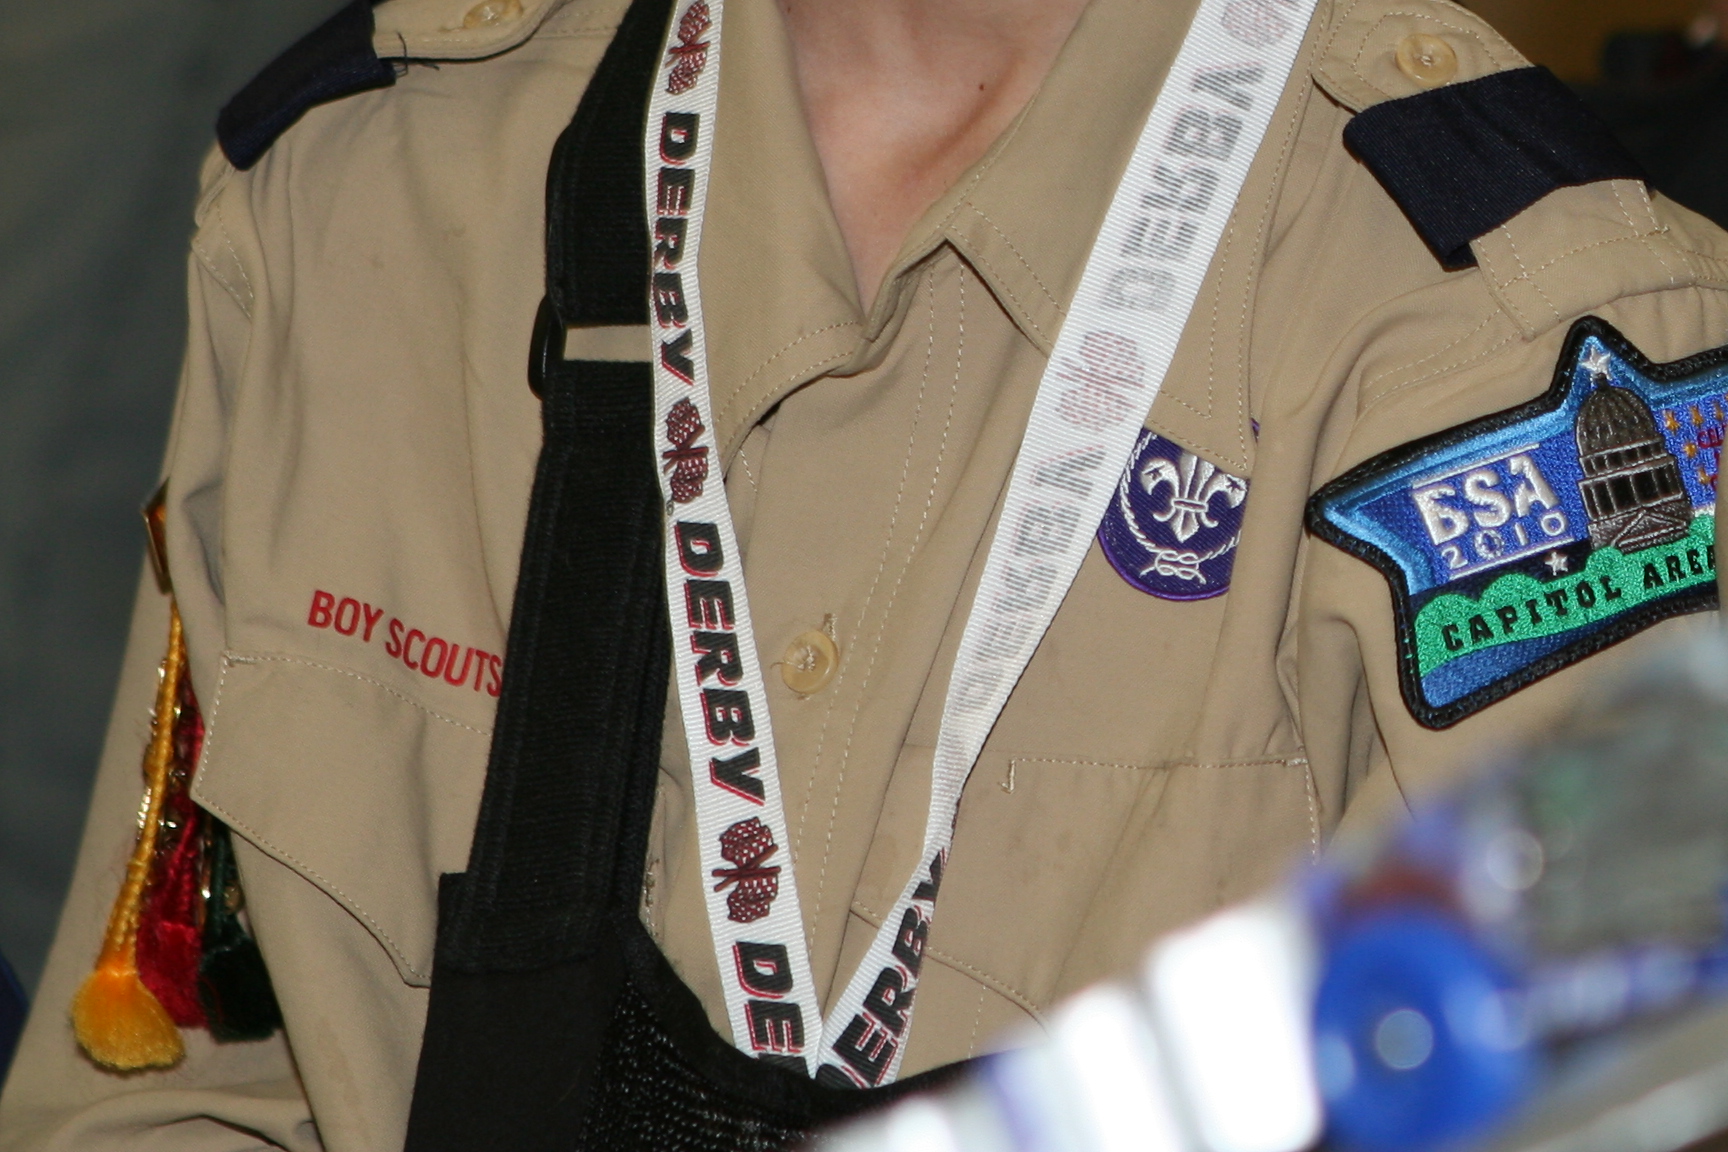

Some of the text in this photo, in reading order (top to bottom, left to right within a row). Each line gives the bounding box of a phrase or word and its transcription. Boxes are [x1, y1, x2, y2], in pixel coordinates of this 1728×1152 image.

[653, 111, 700, 386] DERBY
[1412, 454, 1561, 546] BSA
[1441, 512, 1569, 569] 2010
[307, 589, 502, 697] BOY SCOUTS
[674, 520, 766, 806] DERBY
[1441, 575, 1622, 651] CAPITOL
